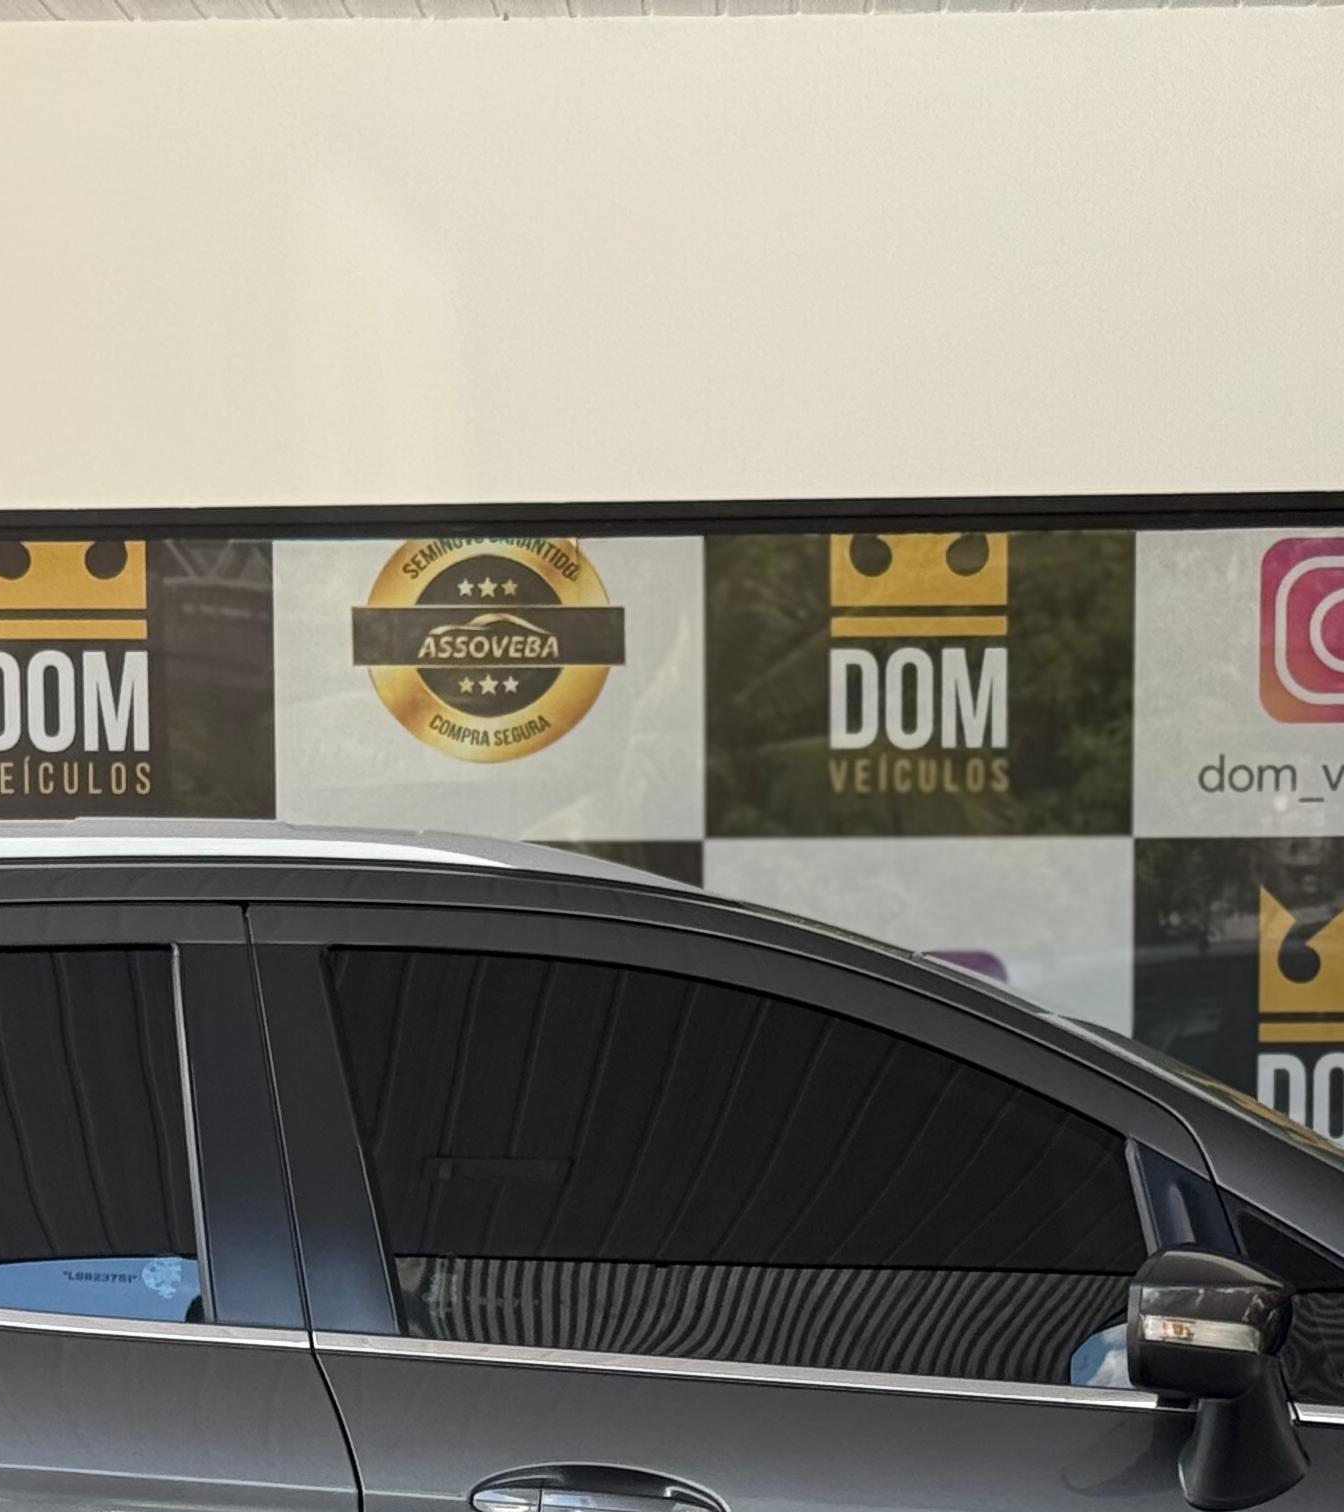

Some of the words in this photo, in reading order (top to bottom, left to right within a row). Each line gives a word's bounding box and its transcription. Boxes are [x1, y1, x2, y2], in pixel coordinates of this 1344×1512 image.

[418, 635, 559, 658] ASSOVEBA
[829, 647, 1008, 750] DOM
[429, 714, 490, 746] COMPRA
[493, 715, 551, 746] SEGURA
[829, 754, 1010, 794] VEÍCULOS
